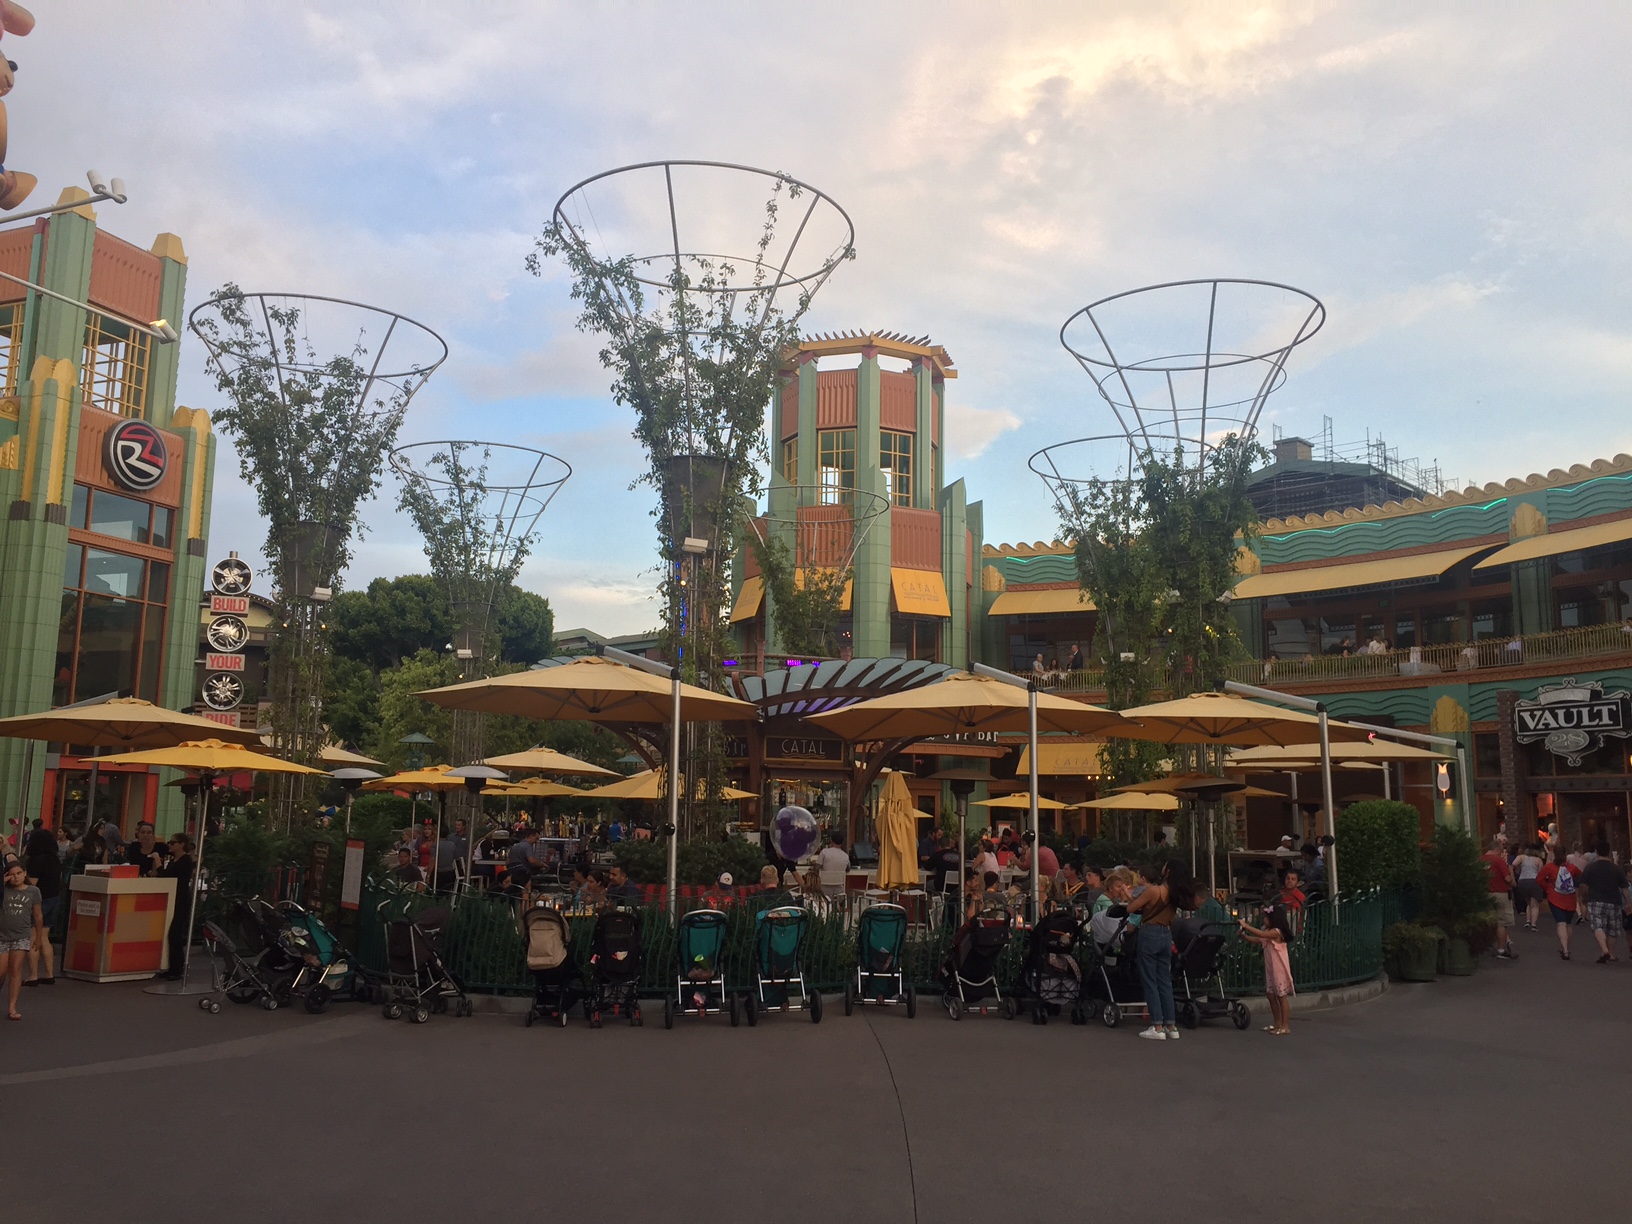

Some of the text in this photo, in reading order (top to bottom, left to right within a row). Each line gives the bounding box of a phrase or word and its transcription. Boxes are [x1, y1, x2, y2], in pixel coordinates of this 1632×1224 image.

[901, 582, 938, 595] CATAL
[213, 597, 247, 612] BUILD
[209, 655, 242, 670] YOUR
[1520, 705, 1616, 730] VAULT
[781, 739, 826, 755] CATAL
[1551, 733, 1584, 746] 28
[1055, 757, 1097, 766] CATAL
